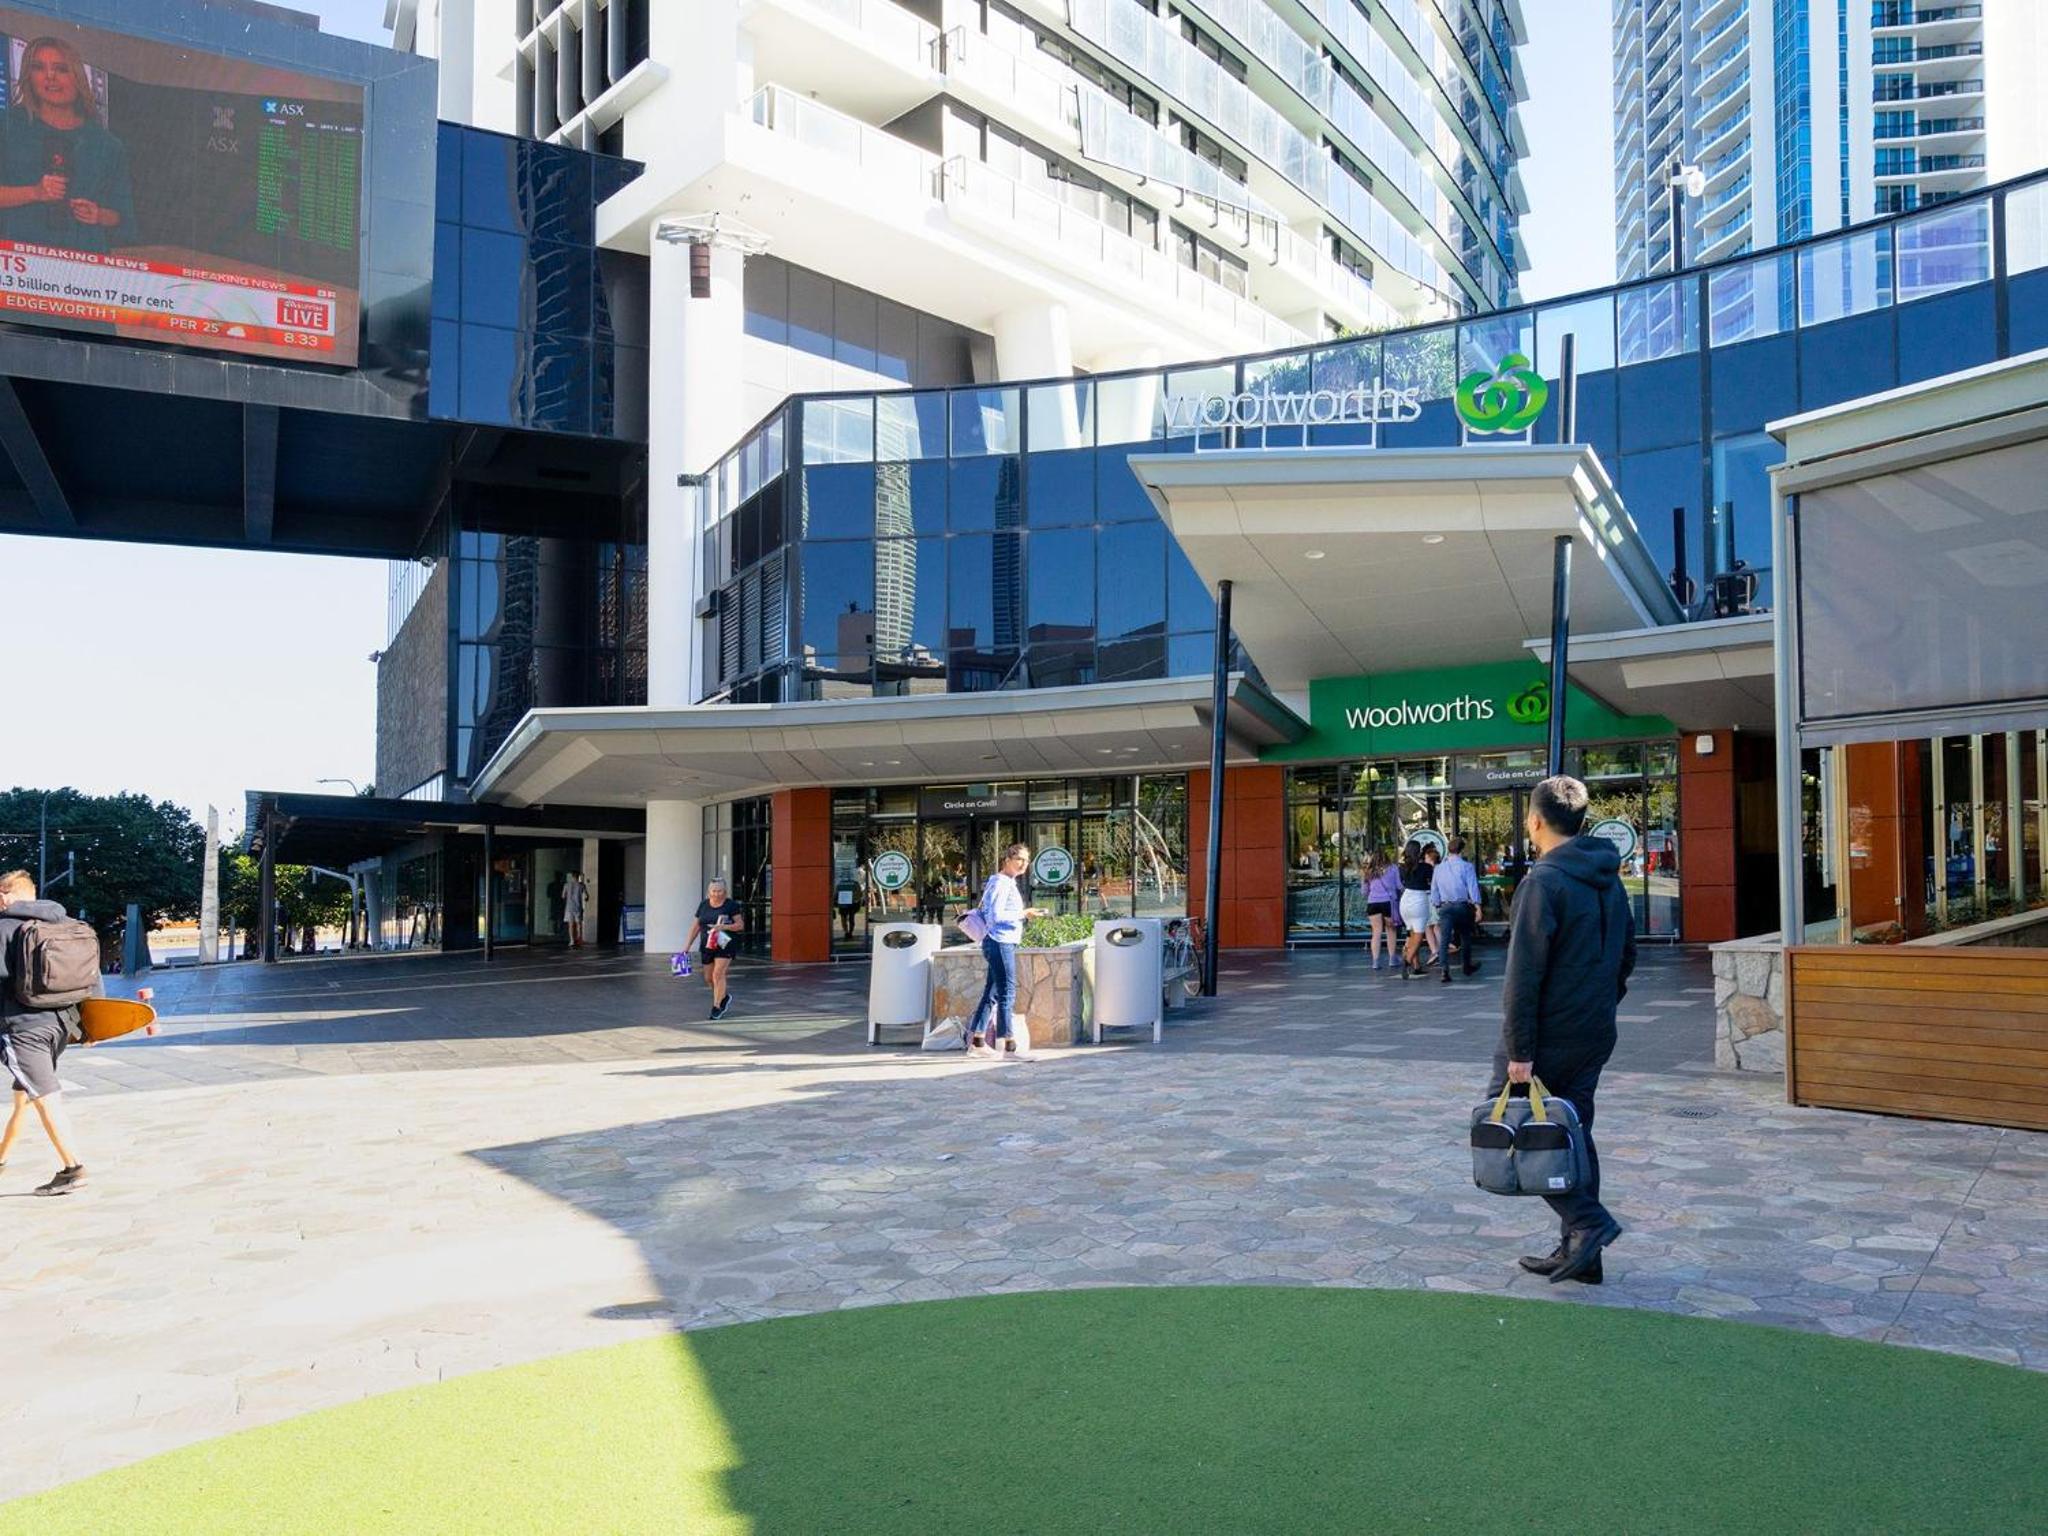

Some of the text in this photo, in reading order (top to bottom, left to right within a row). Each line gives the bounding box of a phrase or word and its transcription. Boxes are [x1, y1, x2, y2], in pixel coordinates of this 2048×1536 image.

[279, 104, 304, 116] ASX
[207, 136, 239, 153] ASX
[13, 243, 149, 271] BREAKING NEWS
[182, 268, 288, 292] BREAKING NEWS
[18, 277, 60, 293] billion
[63, 283, 101, 299] down
[105, 290, 117, 301] 17
[121, 292, 142, 305] per
[147, 297, 174, 310] cent
[6, 294, 106, 319] EDGEWORTH
[169, 317, 197, 330] PER
[282, 309, 323, 328] LIVE
[284, 332, 318, 347] 8.33
[1486, 771, 1511, 780] Circle
